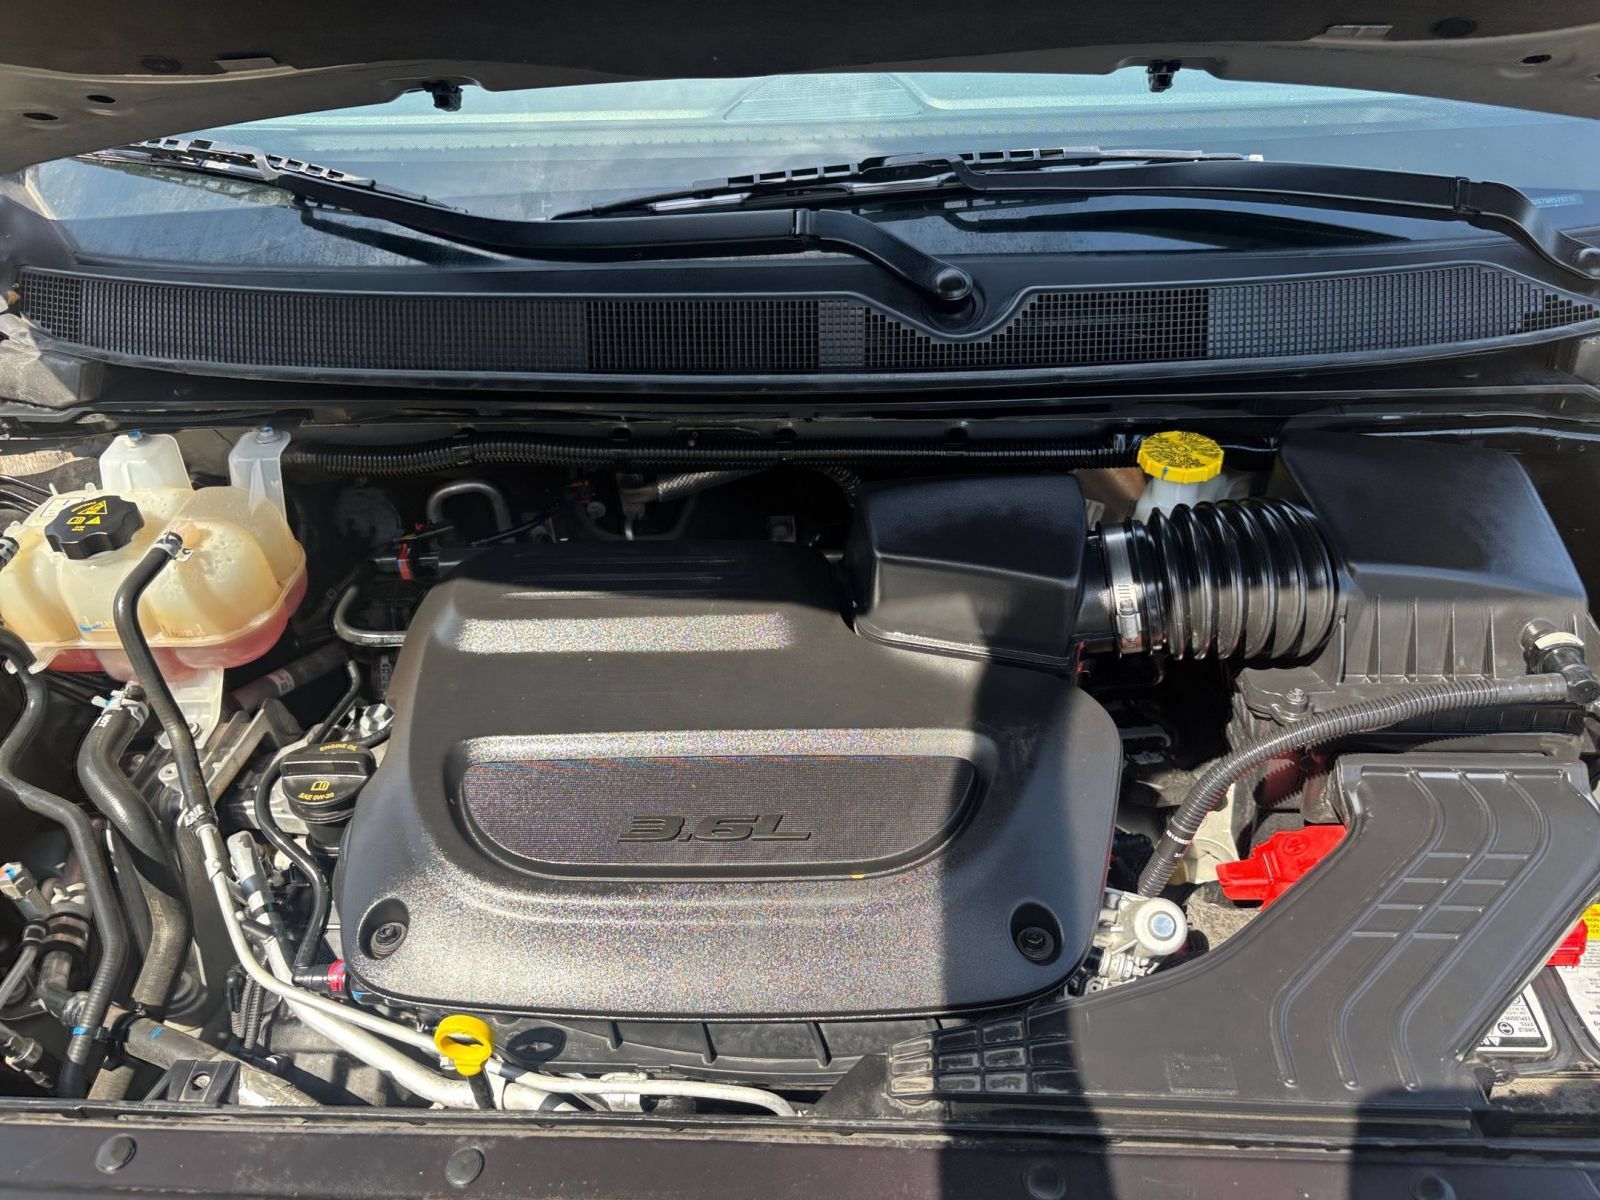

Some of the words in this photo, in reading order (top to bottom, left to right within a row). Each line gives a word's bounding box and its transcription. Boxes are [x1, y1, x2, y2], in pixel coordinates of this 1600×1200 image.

[319, 743, 347, 752] ENGINE
[298, 792, 312, 801] SAE
[618, 814, 811, 843] 3.6L
